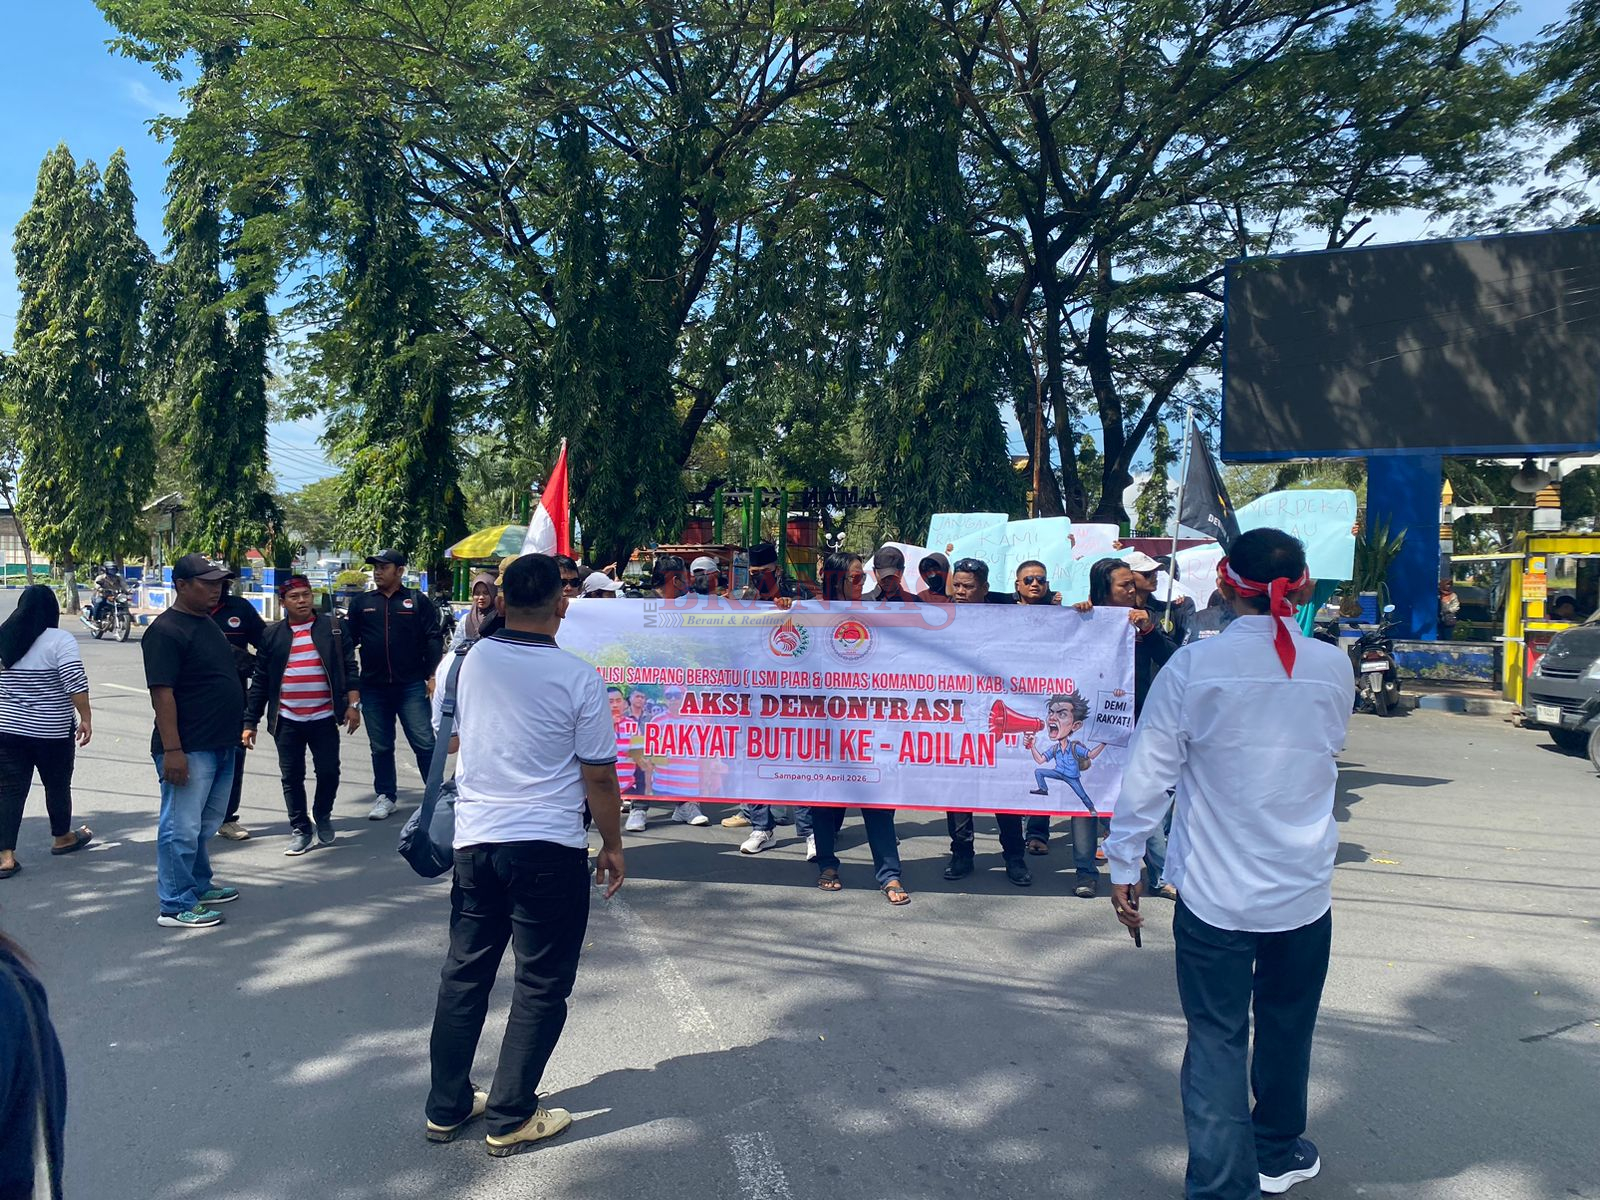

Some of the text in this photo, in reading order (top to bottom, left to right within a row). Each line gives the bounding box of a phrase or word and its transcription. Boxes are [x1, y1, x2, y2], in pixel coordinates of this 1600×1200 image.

[979, 529, 1038, 547] KAMI
[974, 547, 1040, 564] BUTUH
[626, 667, 684, 685] SAMPANG
[686, 669, 740, 686] BERSATU
[751, 671, 777, 687] LSM
[780, 671, 809, 688] PIAR
[812, 672, 821, 688] &
[824, 672, 870, 690] ORMAS
[872, 673, 934, 691] KOMANDO
[976, 677, 1007, 693] KAB.
[1010, 678, 1074, 695] SAMPANG
[679, 692, 964, 722] AKSI DEMONTRASI
[1104, 700, 1127, 712] DEMI
[1096, 713, 1131, 728] RAKYAT!
[644, 723, 740, 758] RAKYAT
[747, 727, 832, 760] BUTUH
[839, 730, 873, 762] KE
[898, 731, 995, 766] ADILAN
[825, 773, 846, 783] April
[847, 774, 867, 783] 2026
